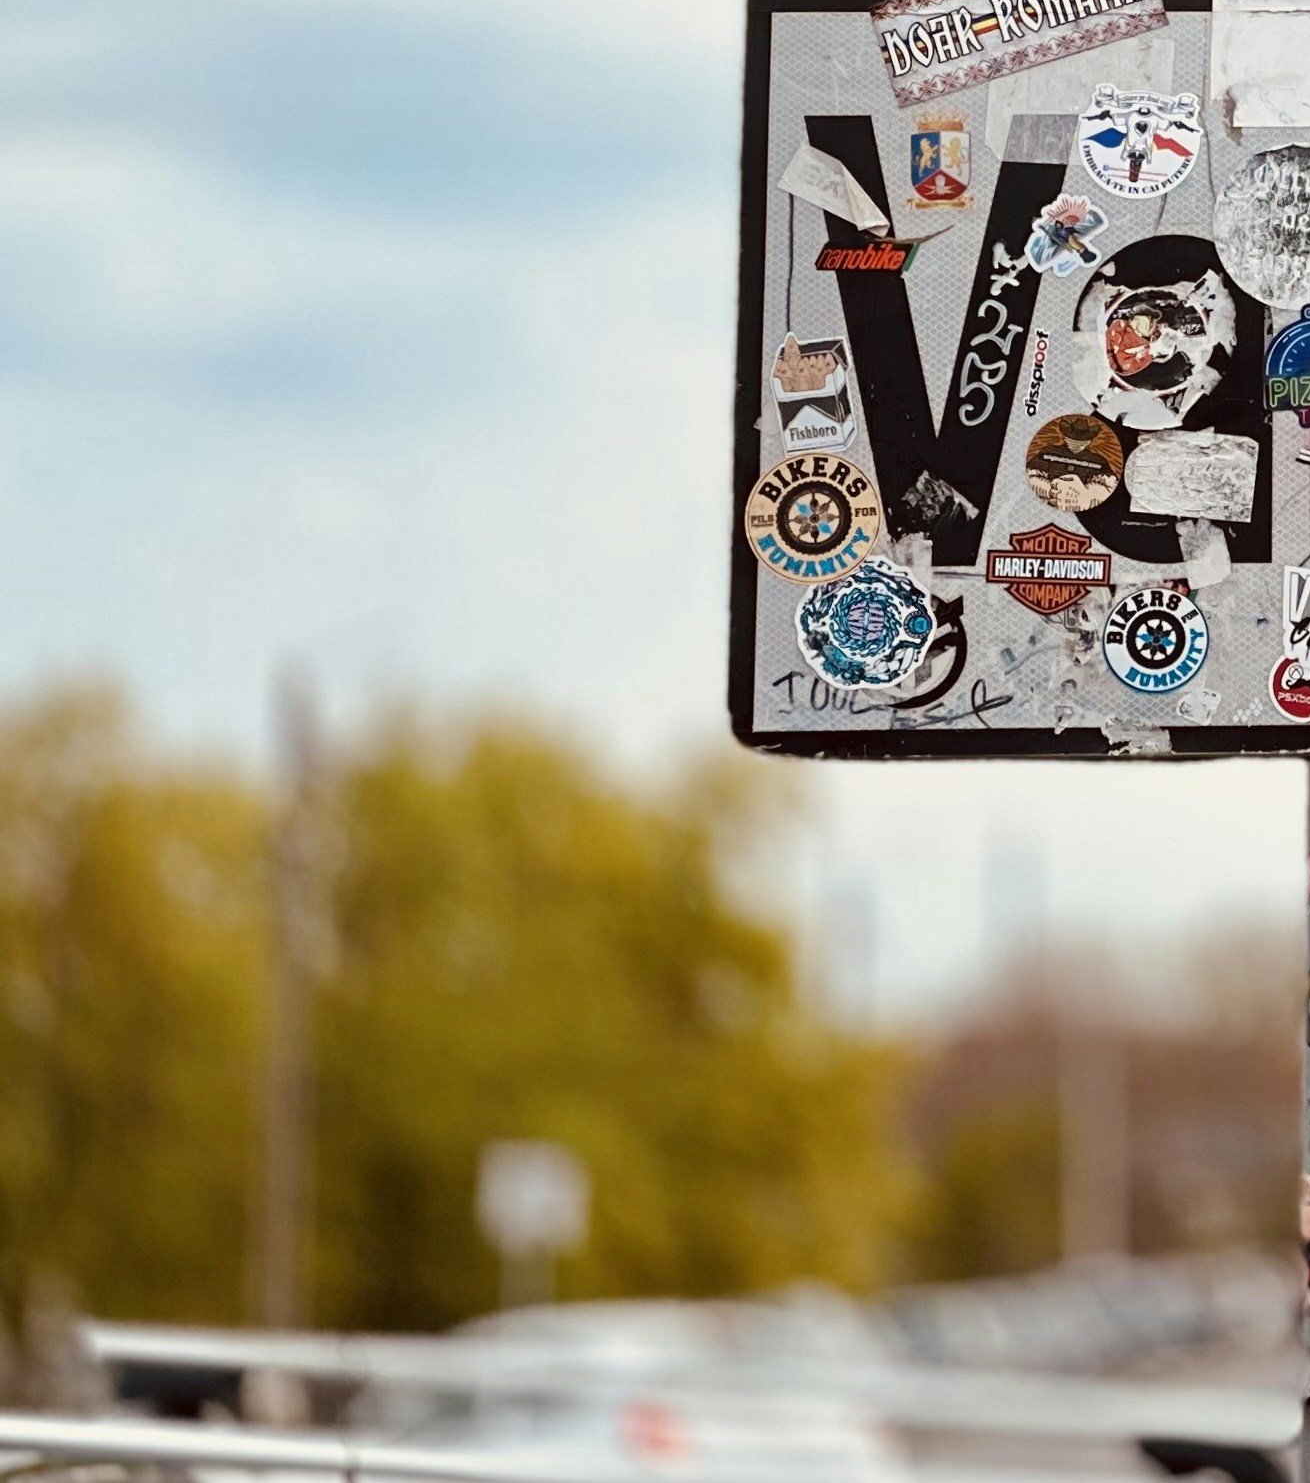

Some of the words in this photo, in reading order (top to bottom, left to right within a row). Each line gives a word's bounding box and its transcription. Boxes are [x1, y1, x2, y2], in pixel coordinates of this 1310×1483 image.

[882, 8, 982, 77] DOAR
[816, 242, 907, 271] nanobike
[1025, 330, 1049, 417] dissproof
[789, 425, 838, 442] Fishboro
[758, 455, 868, 503] BIKERS
[757, 530, 871, 578] HUMANITY
[994, 556, 1104, 580] HARLEY-DAVIDSON
[1021, 535, 1080, 554] MOTOR
[1018, 583, 1078, 609] COMPANY
[1106, 589, 1183, 646] BIKERS
[1124, 627, 1205, 688] HUMANITY
